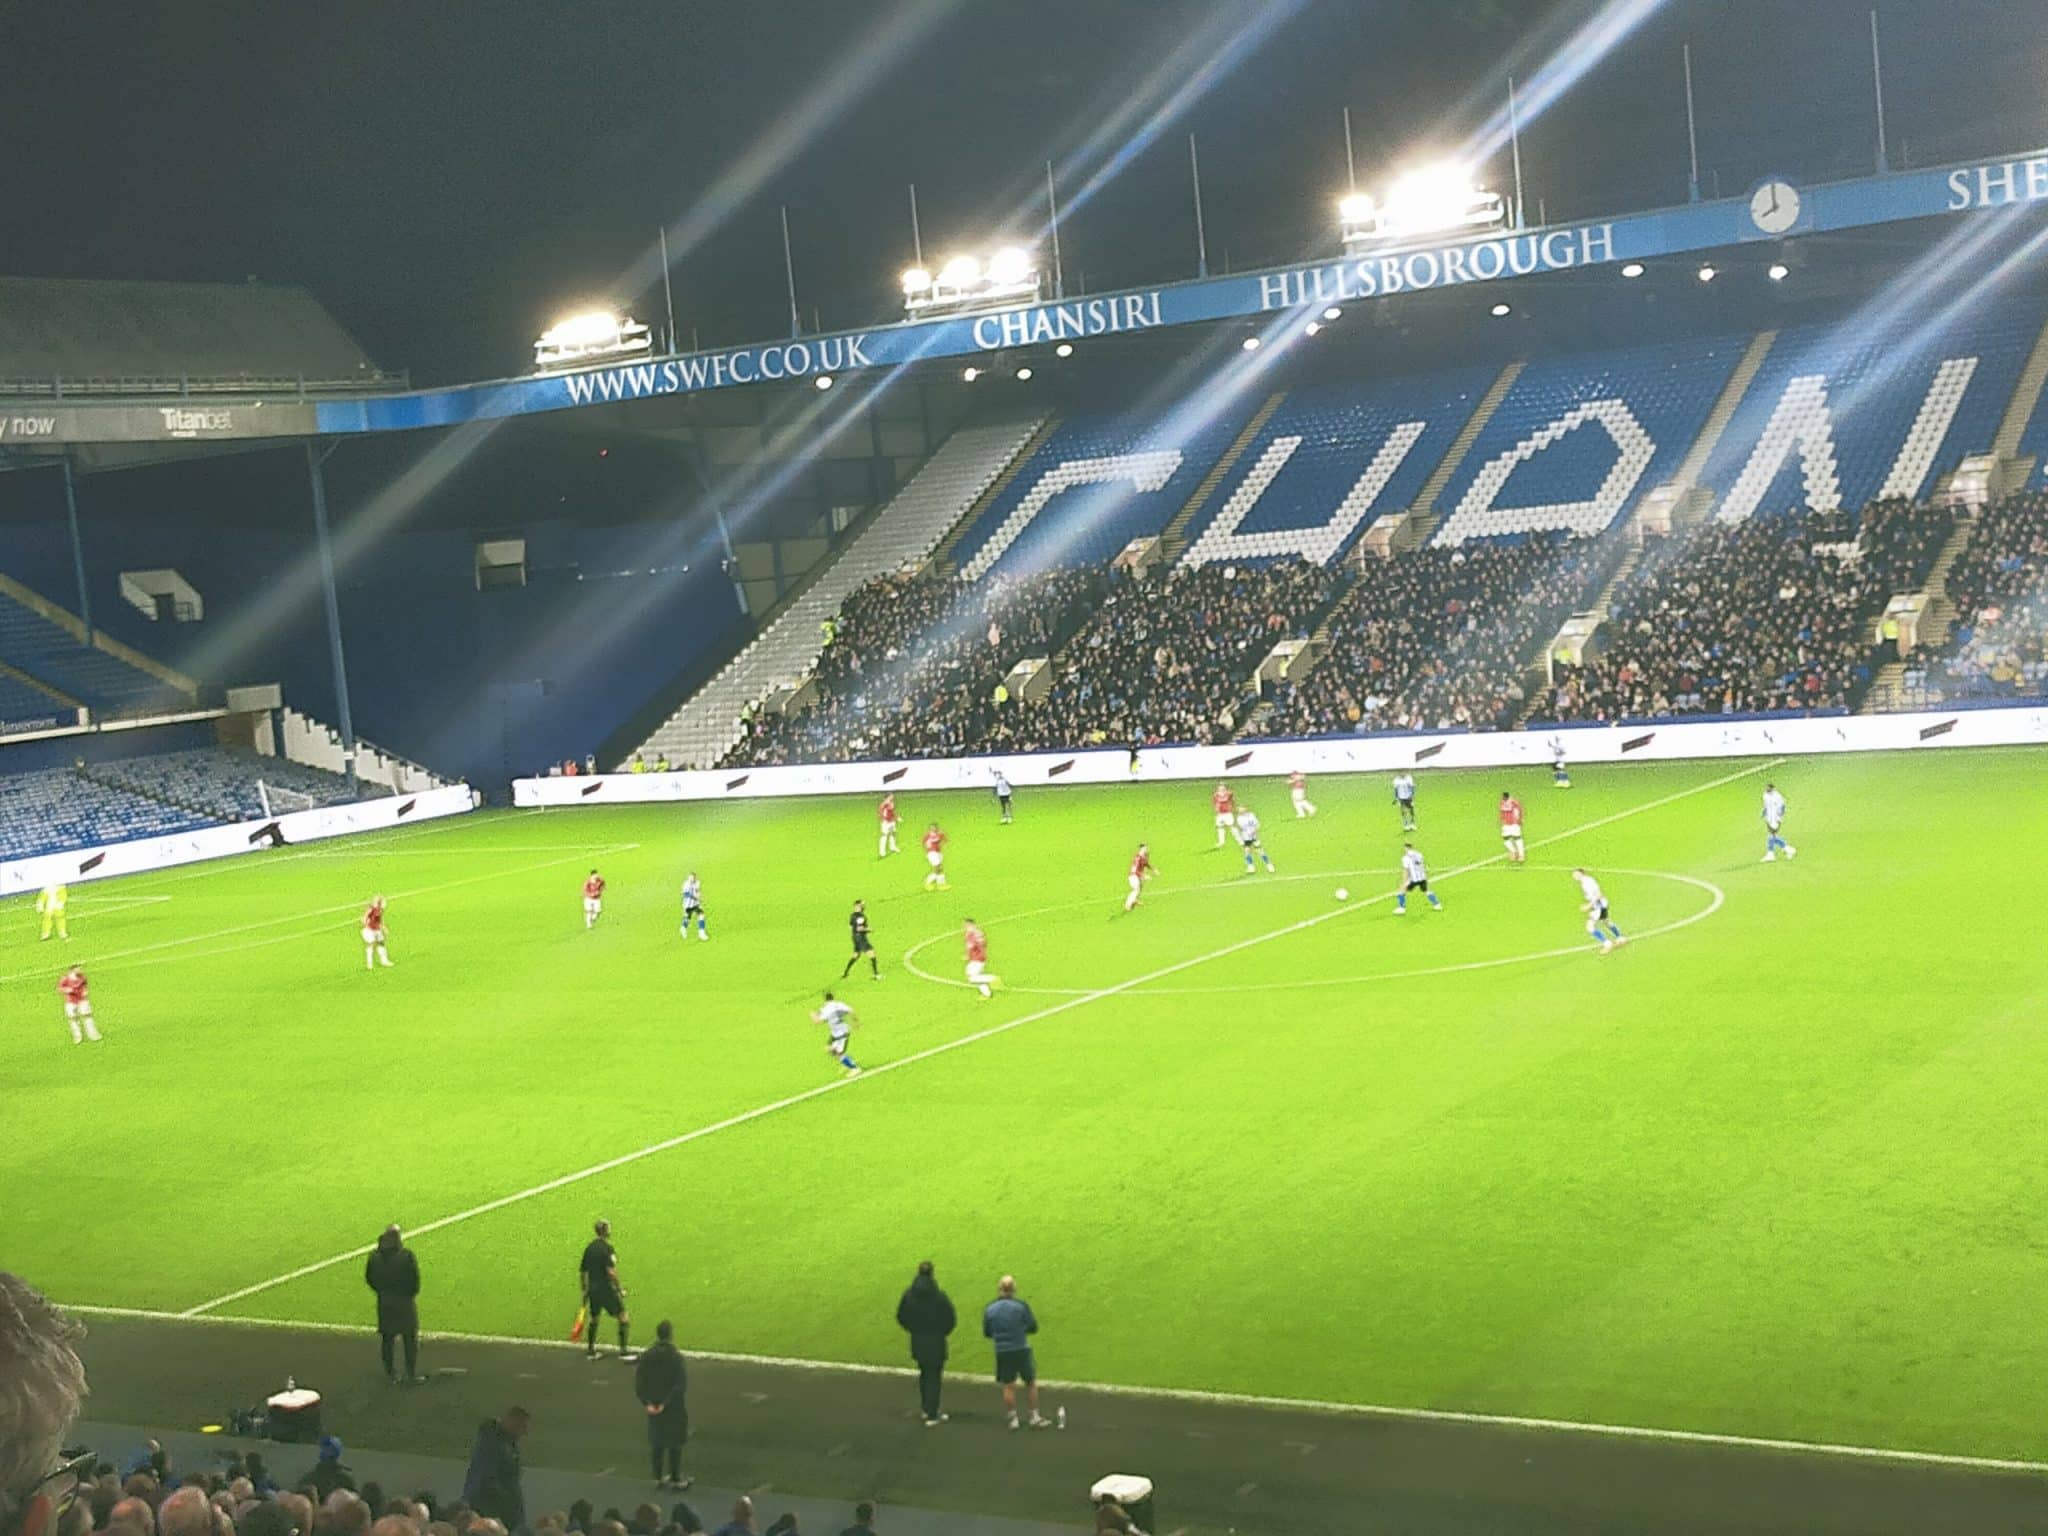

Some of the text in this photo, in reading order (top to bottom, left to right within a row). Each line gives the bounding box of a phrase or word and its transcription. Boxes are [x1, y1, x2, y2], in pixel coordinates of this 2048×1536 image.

[1260, 223, 1615, 311] HILLSBOROUGH
[973, 291, 1164, 349] CHANSIRI
[565, 334, 873, 405] WWW.SWFC.CO.UK
[12, 416, 55, 435] now
